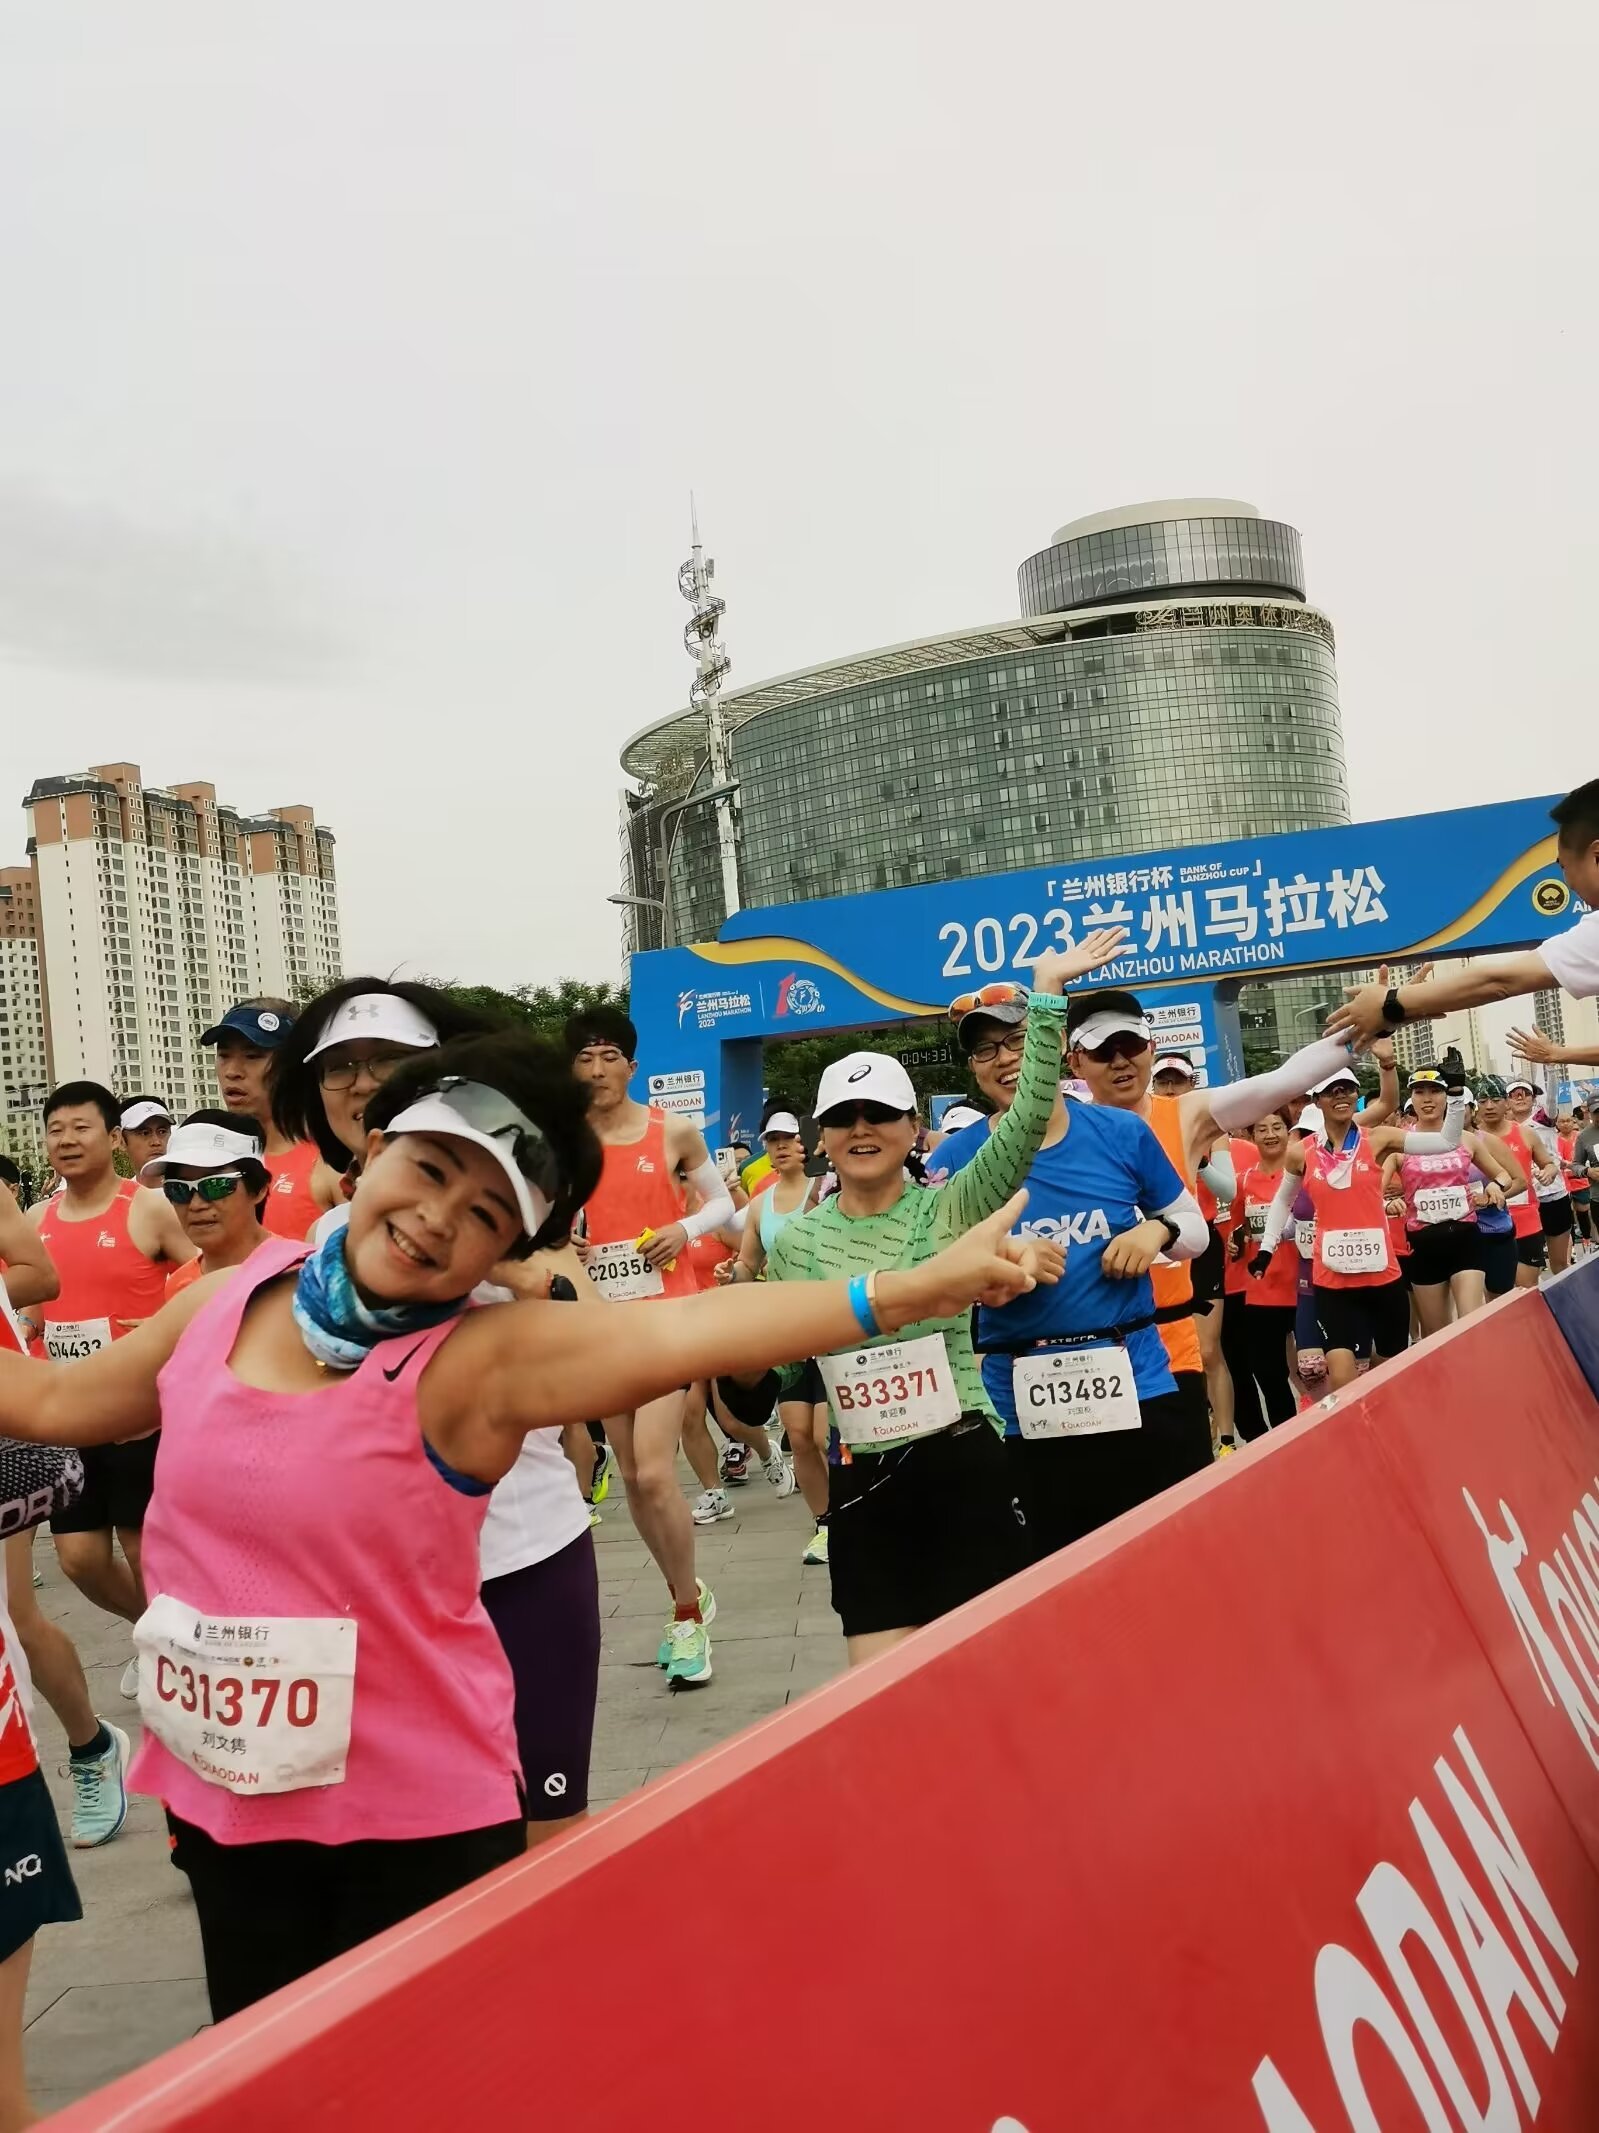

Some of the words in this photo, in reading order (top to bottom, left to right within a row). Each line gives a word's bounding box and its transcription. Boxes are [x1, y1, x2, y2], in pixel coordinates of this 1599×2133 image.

[1180, 864, 1207, 876] BANK
[1209, 862, 1223, 871] OF
[1180, 870, 1227, 884] LANZHOU
[1229, 867, 1250, 877] CUP
[1088, 956, 1174, 982] LANZHOU
[1180, 942, 1285, 971] MARATHON
[696, 994, 752, 1013] 兰州马拉松
[1158, 1006, 1196, 1020] 兰州银行
[698, 1018, 716, 1029] 2023
[1154, 1032, 1200, 1045] QIAODAN
[667, 1073, 701, 1086] 兰州银行
[661, 1097, 702, 1109] QIAODAN
[1420, 1198, 1461, 1212] D31574
[1327, 1243, 1381, 1257] C30359
[588, 1257, 653, 1282] C20356
[835, 1367, 938, 1410] B33371
[1029, 1375, 1123, 1407] C13482
[205, 1624, 270, 1641] 兰州银行
[157, 1655, 319, 1728] C31370
[200, 1759, 260, 1785] QIAODAN
